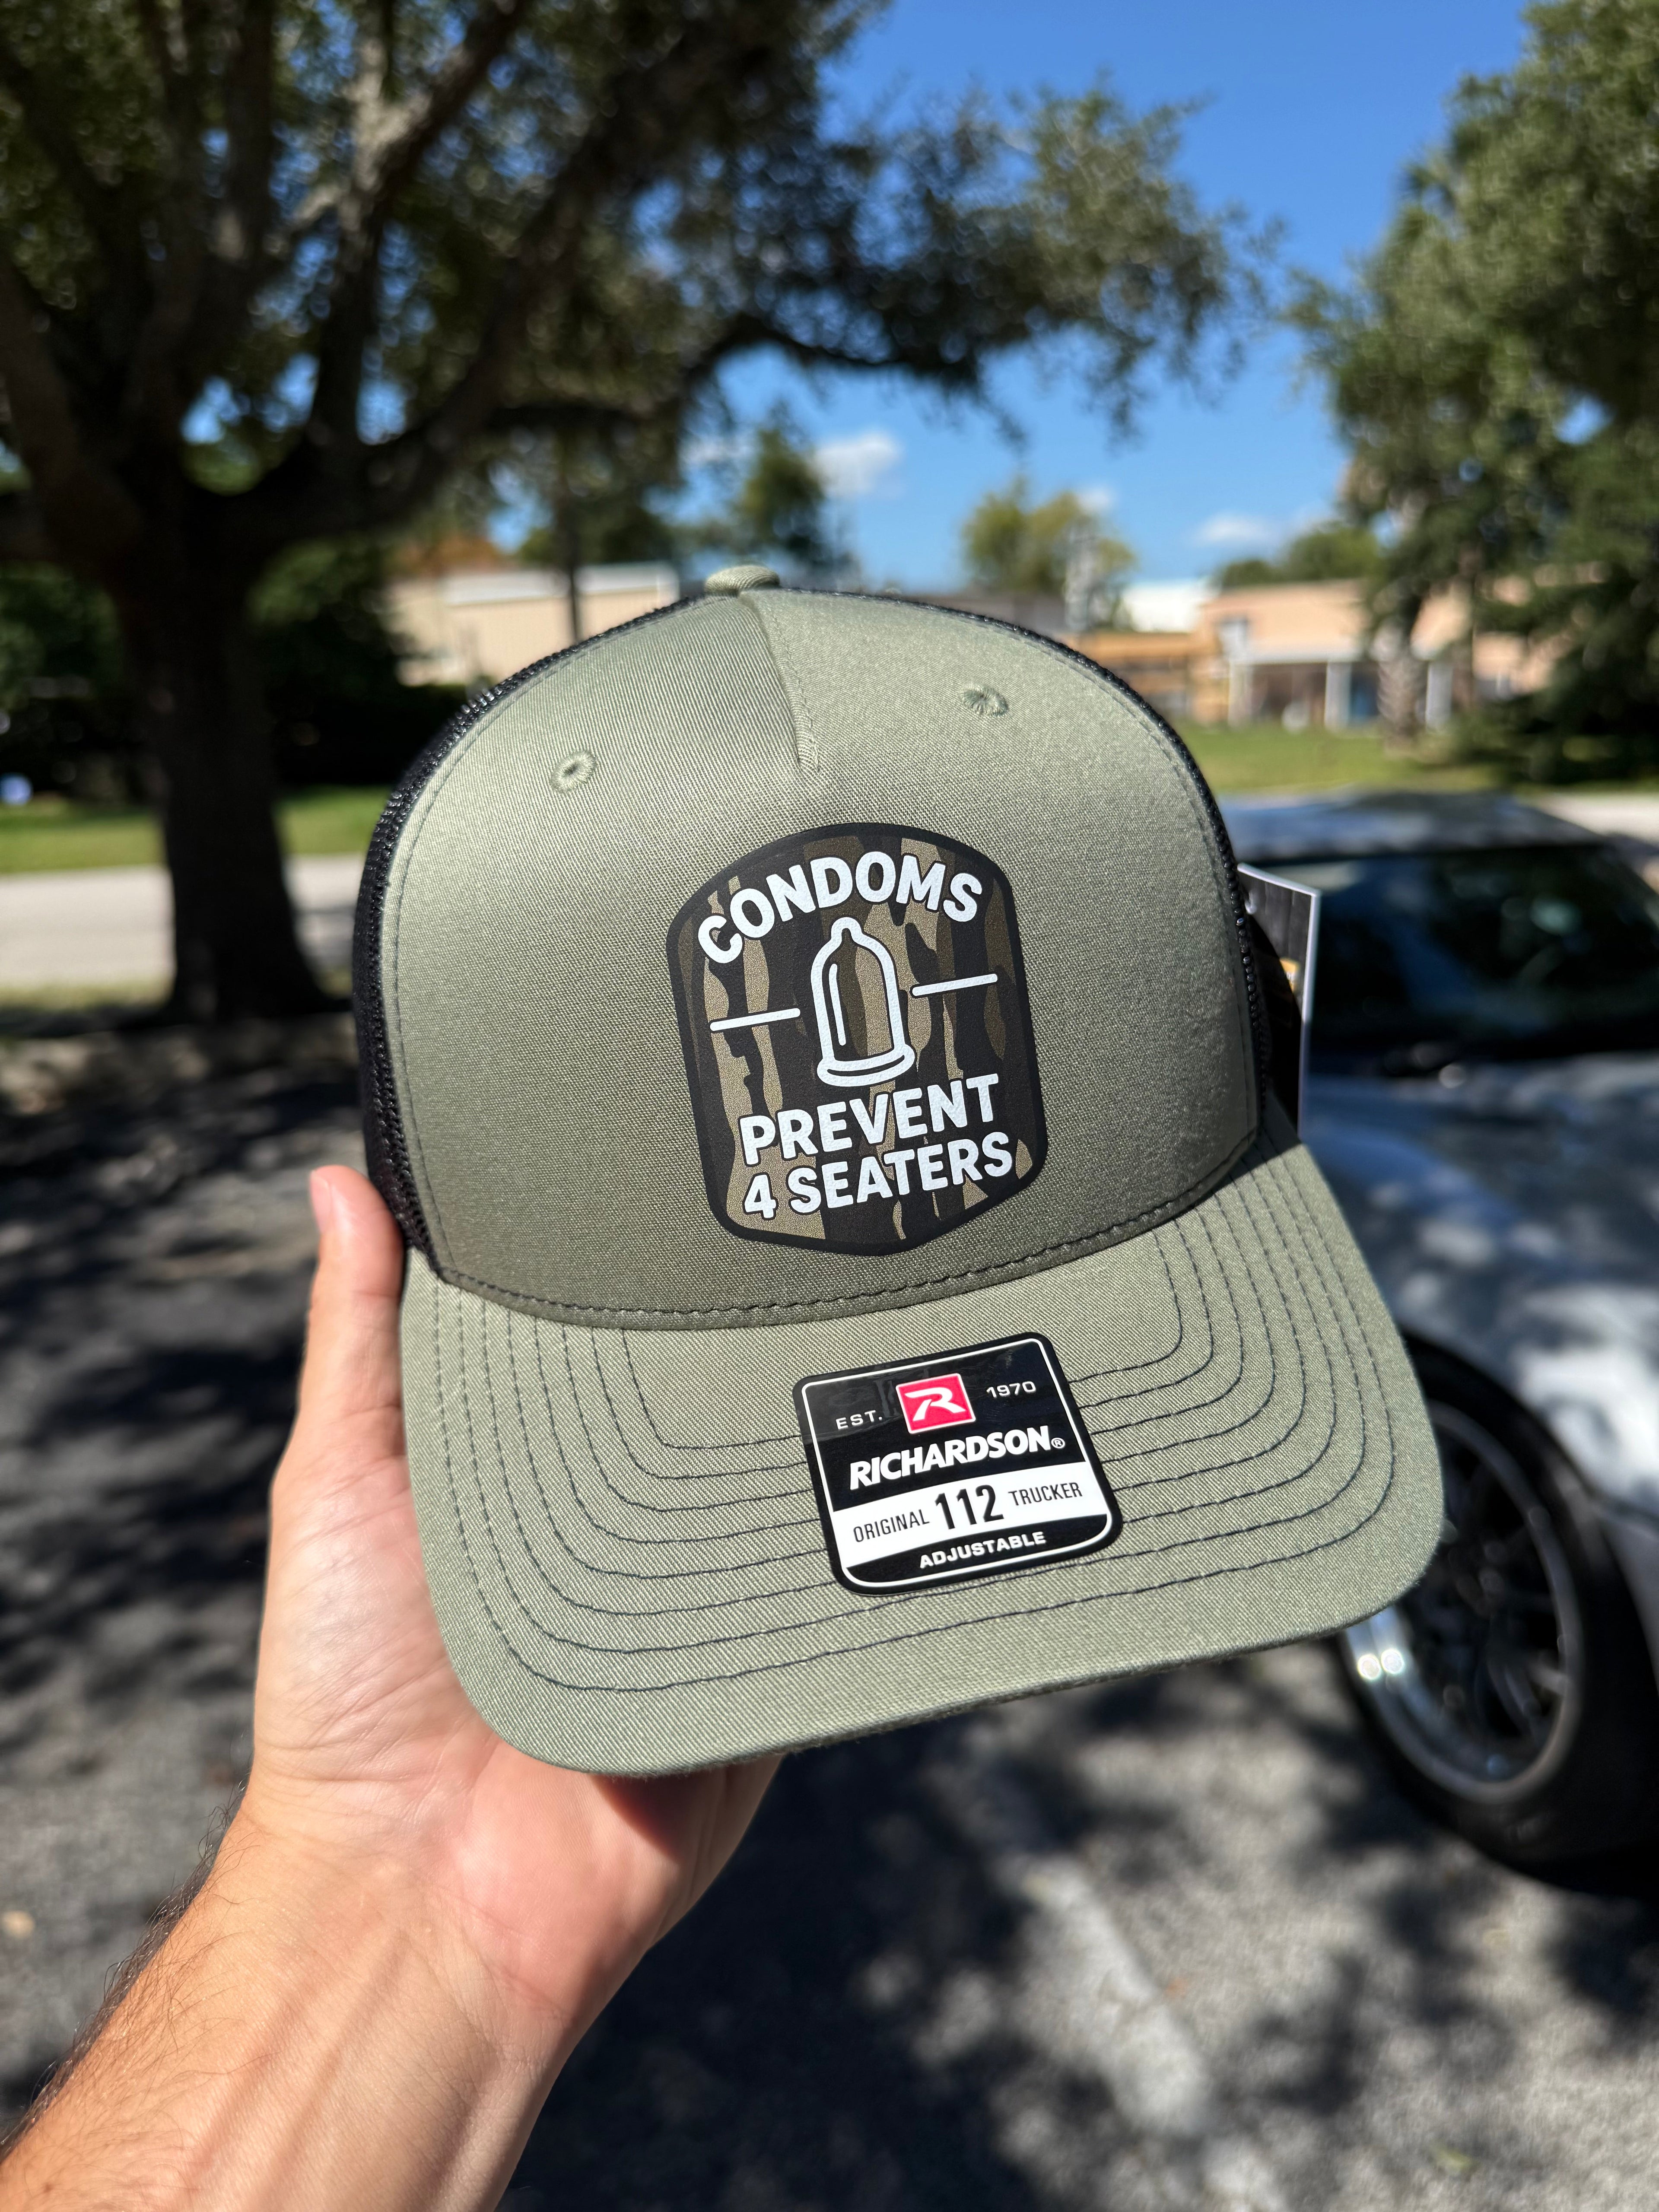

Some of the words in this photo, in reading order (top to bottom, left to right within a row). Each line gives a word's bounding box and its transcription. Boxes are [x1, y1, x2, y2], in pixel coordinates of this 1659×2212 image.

[697, 851, 983, 964] CONDOMS
[739, 1073, 999, 1165] PREVENT
[744, 1174, 777, 1219] 4
[788, 1131, 1013, 1214] SEATERS
[836, 1409, 883, 1430] EST.
[986, 1380, 1036, 1398] 1970
[853, 1509, 930, 1543] ORIGINAL
[934, 1484, 1004, 1530] 112
[1008, 1482, 1083, 1506] TRUCKER
[919, 1531, 1046, 1569] ADJUSTABLE
